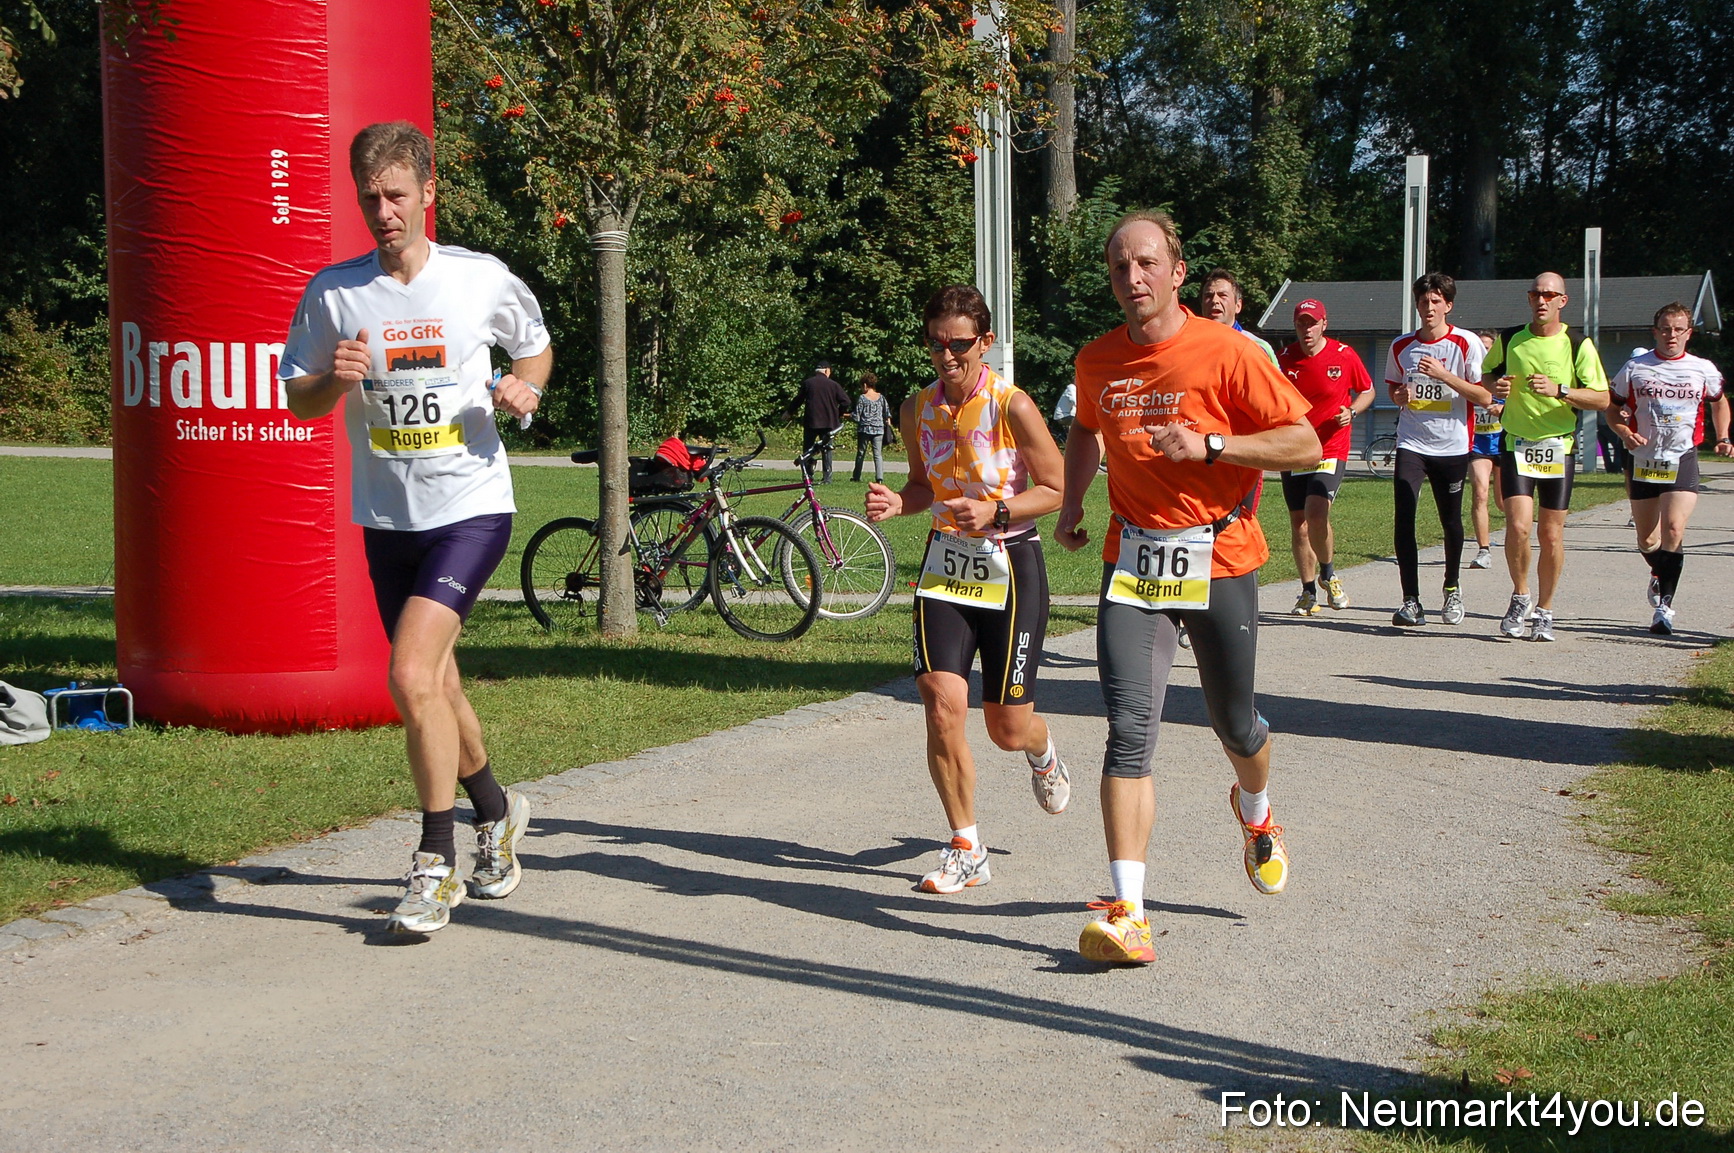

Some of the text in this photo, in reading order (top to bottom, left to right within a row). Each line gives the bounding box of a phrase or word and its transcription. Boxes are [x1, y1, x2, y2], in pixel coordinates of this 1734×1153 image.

[270, 149, 290, 224] Seit 1929
[383, 325, 444, 341] Go GfK
[122, 322, 288, 410] Braun
[374, 378, 415, 388] PFLEIDERER
[1415, 384, 1442, 400] 988
[1111, 389, 1186, 408] Fischer
[1636, 387, 1700, 399] ICEHOUSE
[383, 392, 441, 426] 126
[1117, 407, 1179, 418] AUTOMOBILE
[1475, 413, 1491, 424] 247
[176, 418, 314, 441] Sicher ist sicher
[390, 429, 440, 449] Roger
[1525, 448, 1554, 463] 659
[1641, 468, 1670, 479] Markus
[944, 548, 989, 581] 575
[1136, 544, 1189, 577] 616
[448, 580, 467, 594] asics
[945, 579, 983, 598] Klara
[1136, 579, 1182, 597] Bernd
[1012, 631, 1030, 685] SKINS
